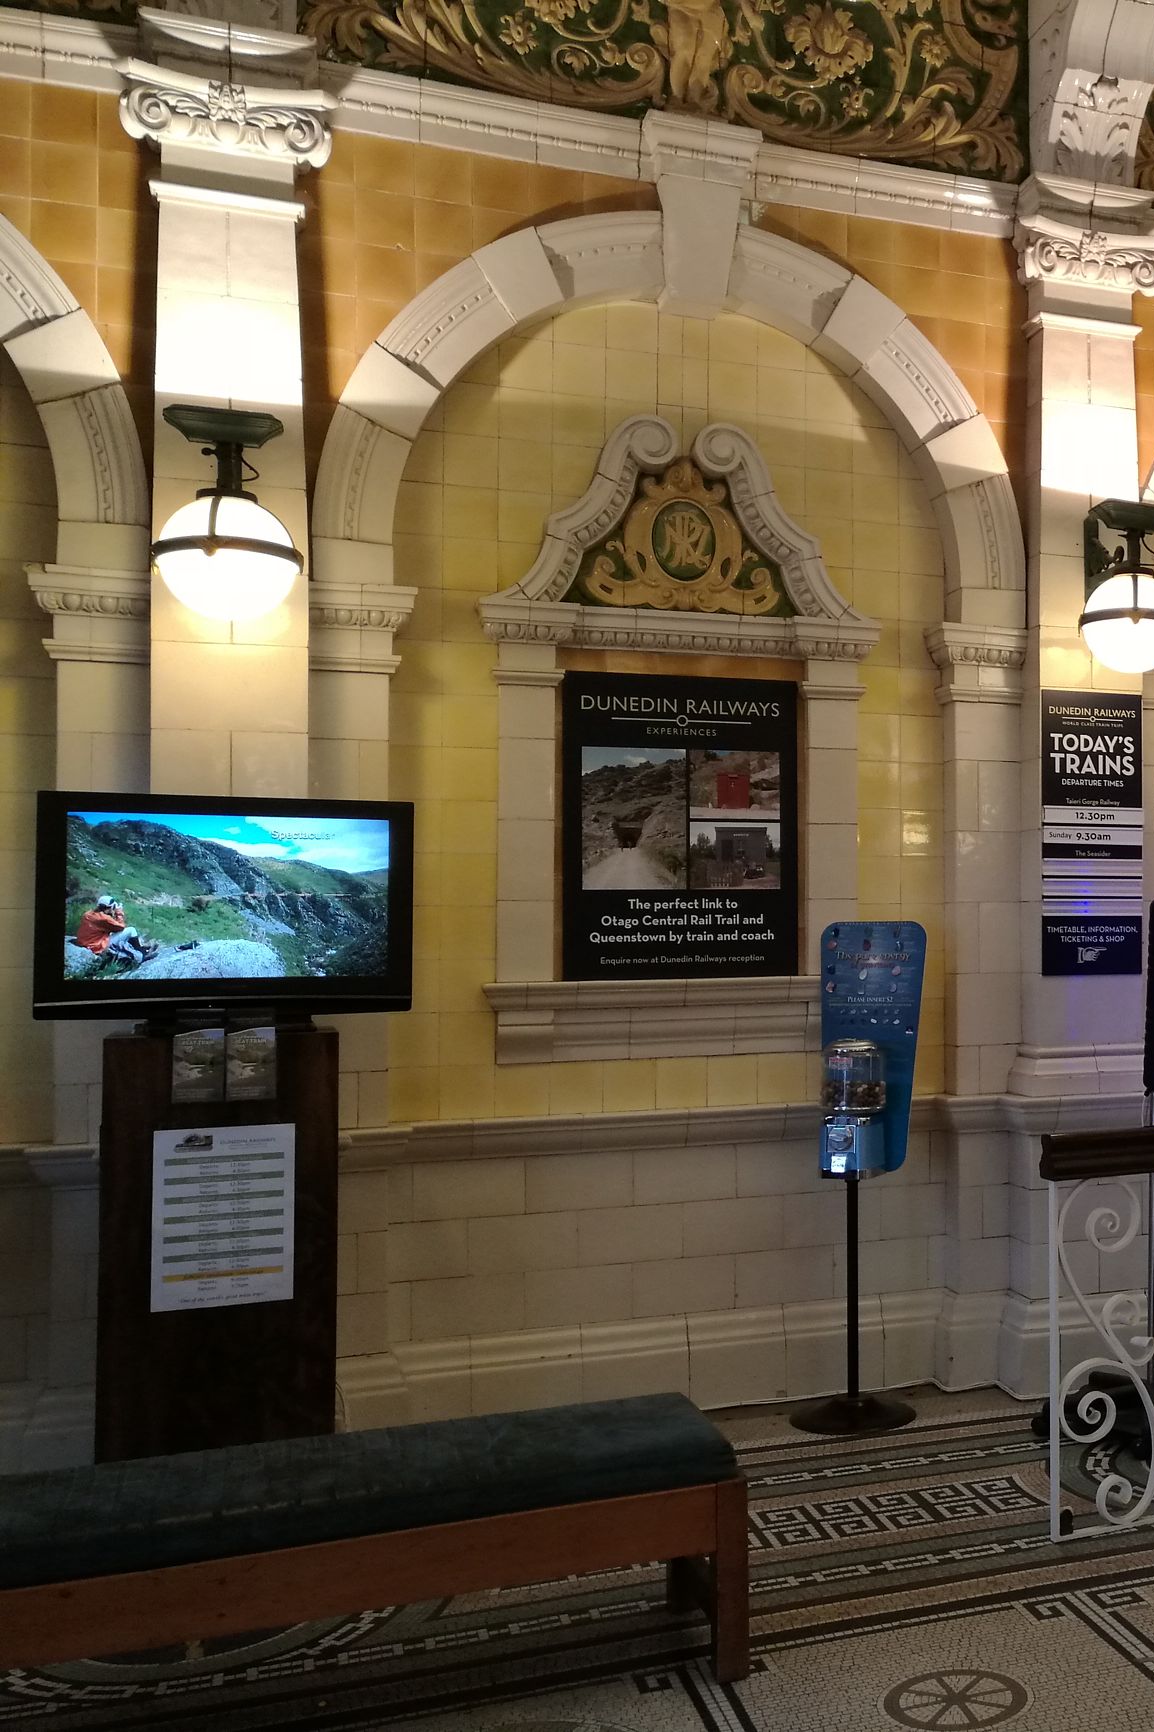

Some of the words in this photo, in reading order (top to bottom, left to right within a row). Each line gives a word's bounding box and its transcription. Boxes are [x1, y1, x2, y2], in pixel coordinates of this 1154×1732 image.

[580, 694, 678, 714] DUNEDIN
[686, 699, 780, 718] RAILWAYS
[1048, 706, 1091, 716] DUNEDIN
[1094, 708, 1136, 718] RAILWAYS
[646, 727, 717, 737] EXPERIENCES
[1049, 733, 1135, 754] TODAY'S
[1049, 753, 1135, 776] TRAINS
[1061, 778, 1102, 787] DEPARTURE
[1103, 779, 1124, 788] TIMES
[1065, 797, 1081, 805] Taieri
[1081, 798, 1099, 806] Gorge
[1100, 799, 1120, 807] Railway
[1075, 812, 1115, 821] 12.30pm
[1049, 832, 1072, 840] Sunday
[1076, 832, 1111, 841] 9.30am
[628, 899, 650, 910] The
[654, 898, 699, 912] perfect
[702, 898, 723, 910] link
[726, 899, 738, 910] to
[601, 915, 639, 930] Otago
[642, 915, 687, 926] Central
[691, 914, 712, 926] Rail
[715, 914, 740, 925] Trail
[743, 914, 764, 925] and
[1047, 926, 1087, 934] TIMETABLE,
[1088, 926, 1138, 935] INFORMATION,
[589, 932, 666, 944] Queenstown
[669, 931, 684, 945] by
[687, 931, 714, 942] train
[717, 930, 738, 941] and
[741, 930, 775, 941] coach
[1060, 935, 1099, 943] TICKETING
[1105, 935, 1125, 943] SHOP
[600, 956, 630, 966] Enquire
[651, 956, 659, 964] at
[660, 955, 693, 964] Dunedin
[695, 955, 727, 965] Railways
[728, 954, 765, 964] reception
